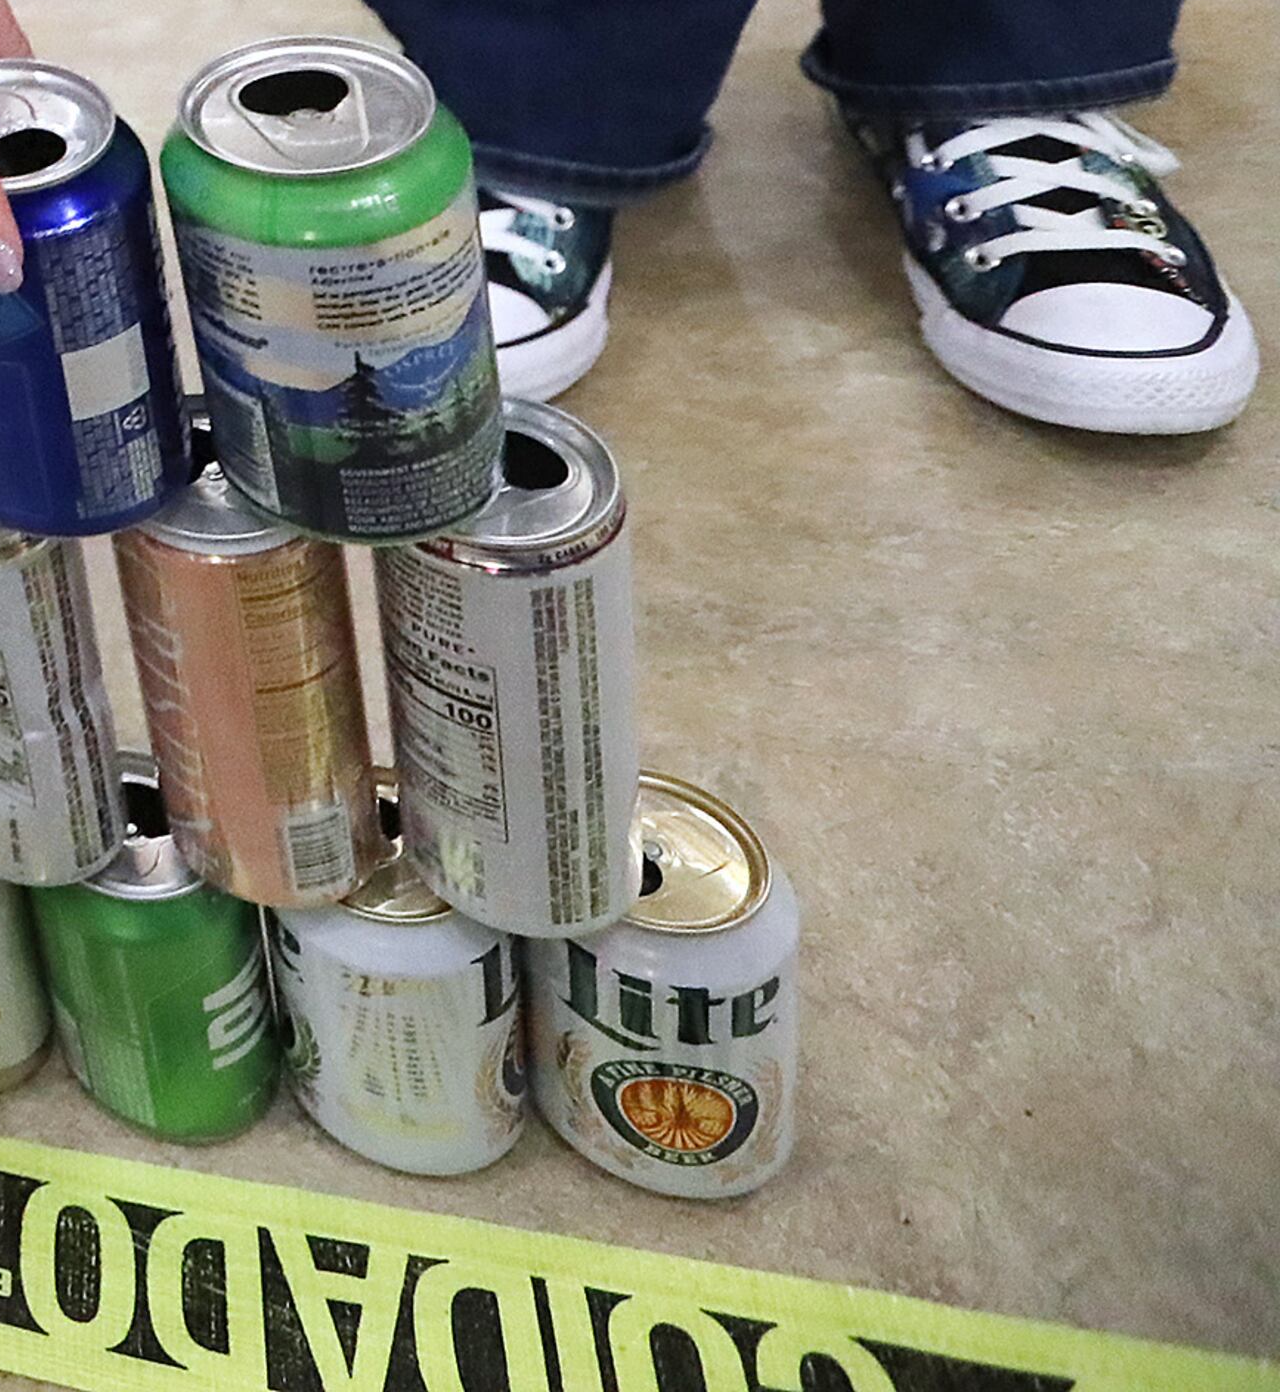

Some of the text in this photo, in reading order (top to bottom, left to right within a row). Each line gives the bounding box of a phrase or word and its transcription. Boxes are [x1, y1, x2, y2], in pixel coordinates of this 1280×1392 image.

[554, 541, 589, 562] CARBS
[445, 702, 493, 730] 100
[555, 938, 781, 1051] Lite
[597, 1062, 754, 1106] A FINE PILSNER
[642, 1140, 714, 1165] BEER
